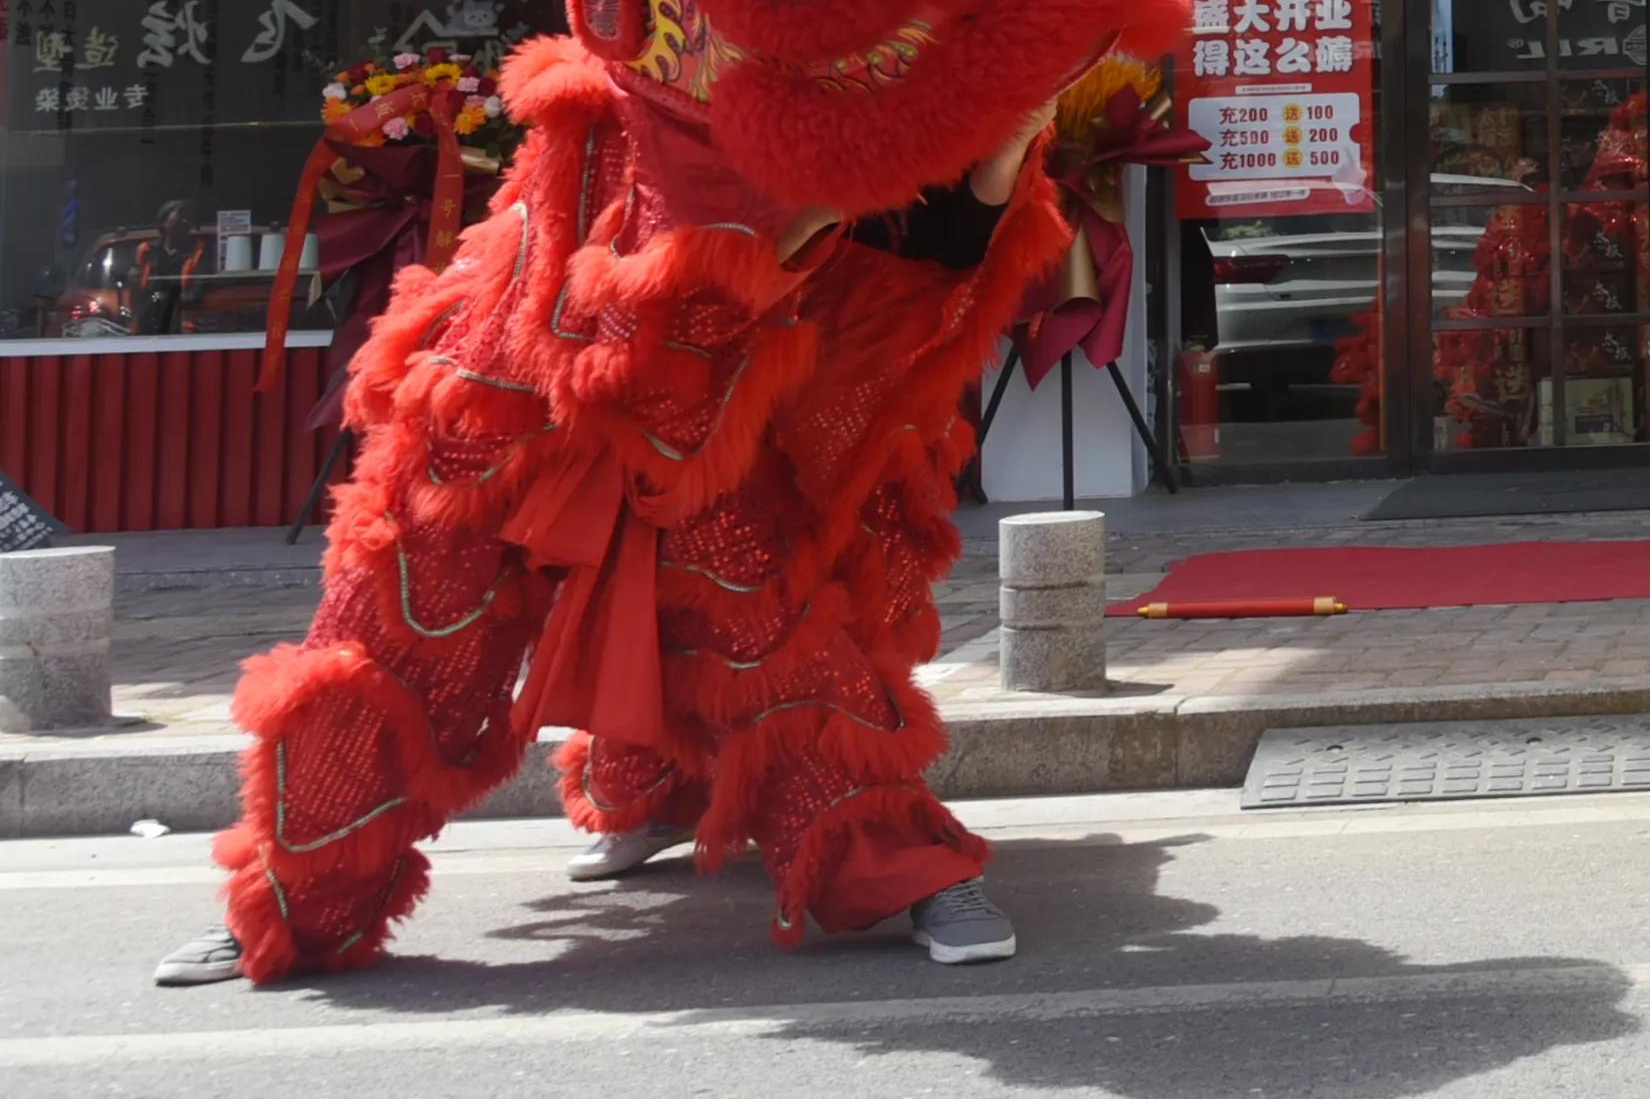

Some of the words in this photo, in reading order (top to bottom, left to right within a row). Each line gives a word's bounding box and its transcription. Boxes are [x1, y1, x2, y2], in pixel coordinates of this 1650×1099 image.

[1219, 106, 1269, 125] 充200
[1306, 105, 1334, 120] 100
[1219, 128, 1270, 147] 充500
[1309, 128, 1338, 143] 200
[1219, 151, 1277, 171] 充1000
[1310, 151, 1340, 165] 500
